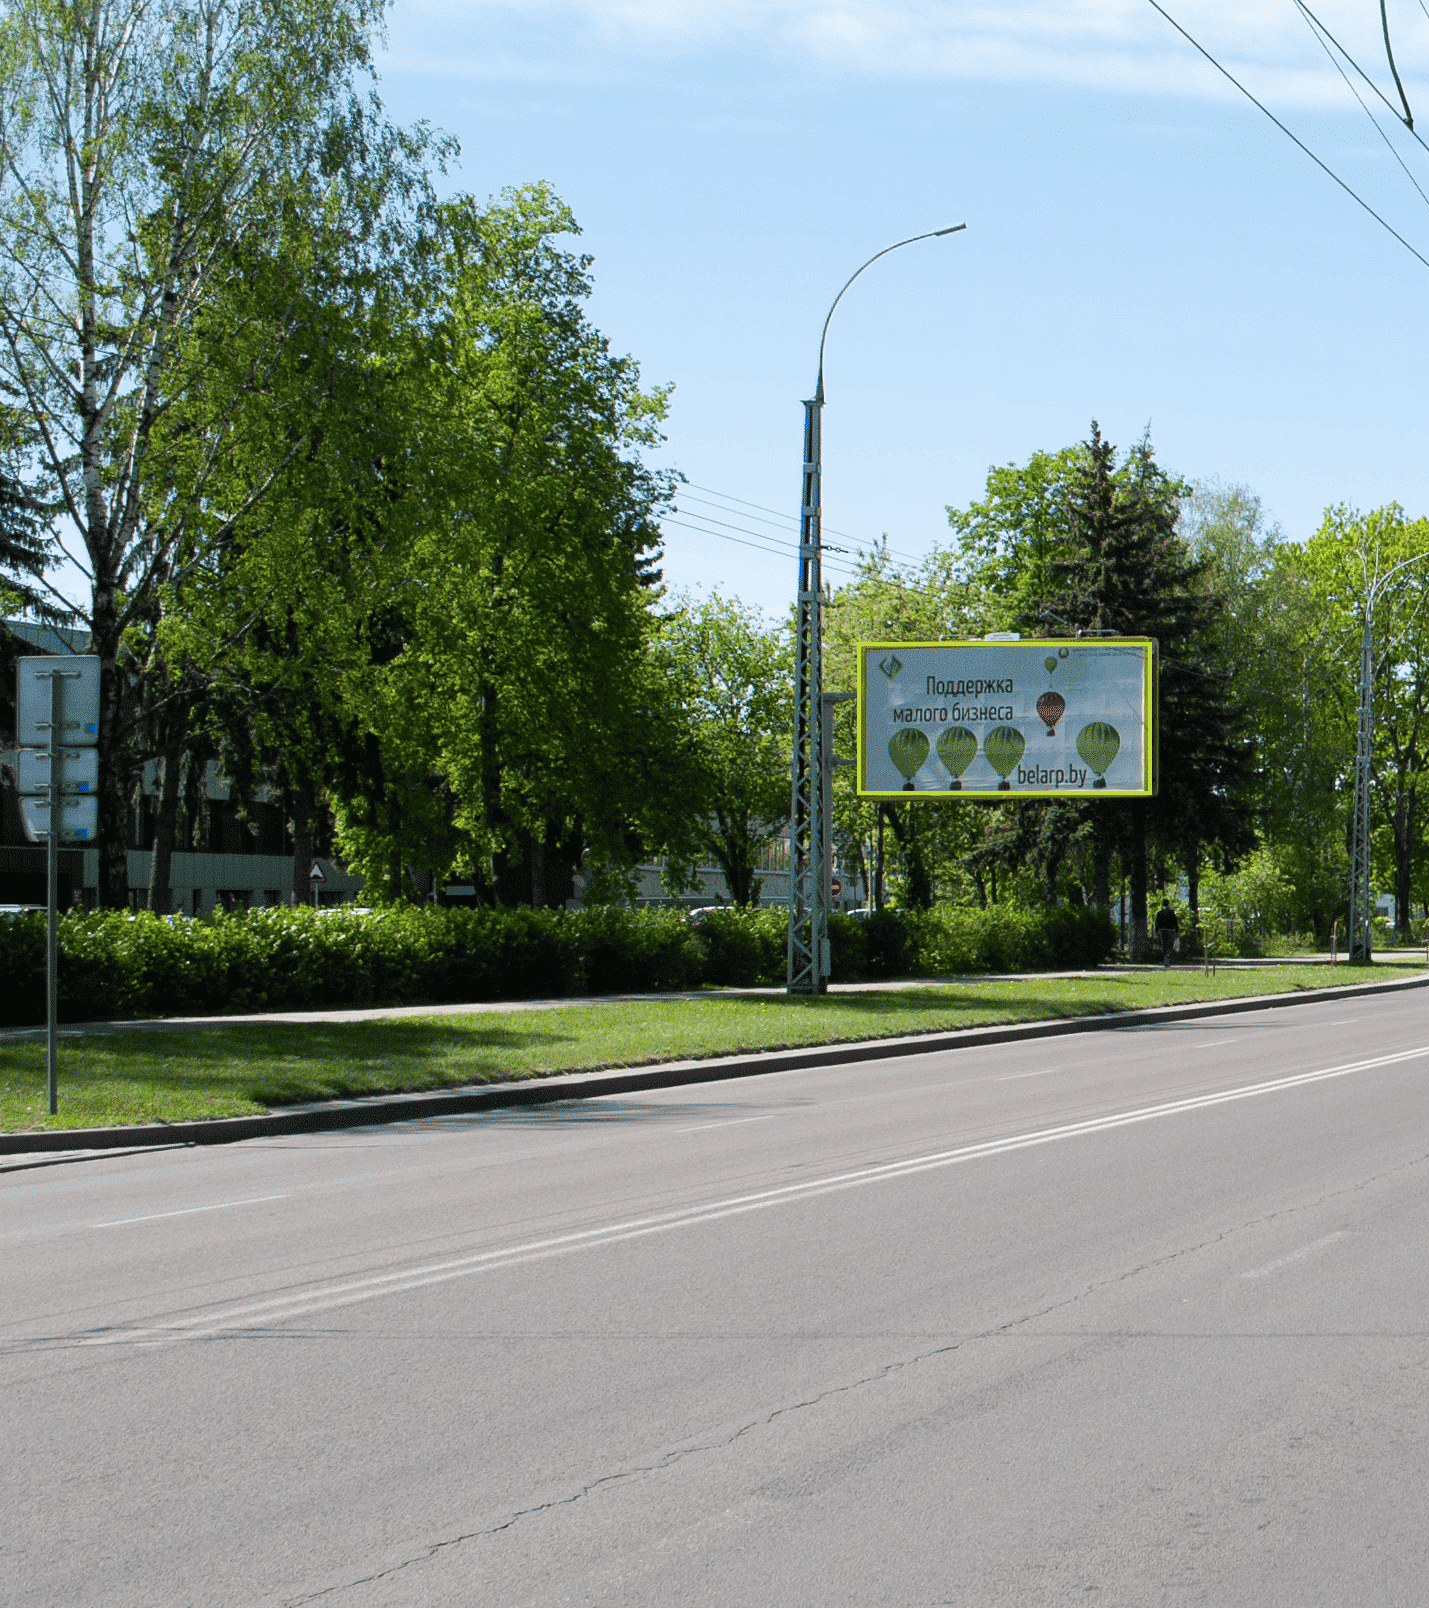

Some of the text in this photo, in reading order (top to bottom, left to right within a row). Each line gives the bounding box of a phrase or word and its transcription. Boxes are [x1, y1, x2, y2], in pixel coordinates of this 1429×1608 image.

[926, 675, 1014, 699] Поддержка
[893, 701, 1014, 723] малого бизнеса
[1017, 763, 1087, 788] belarp.by
